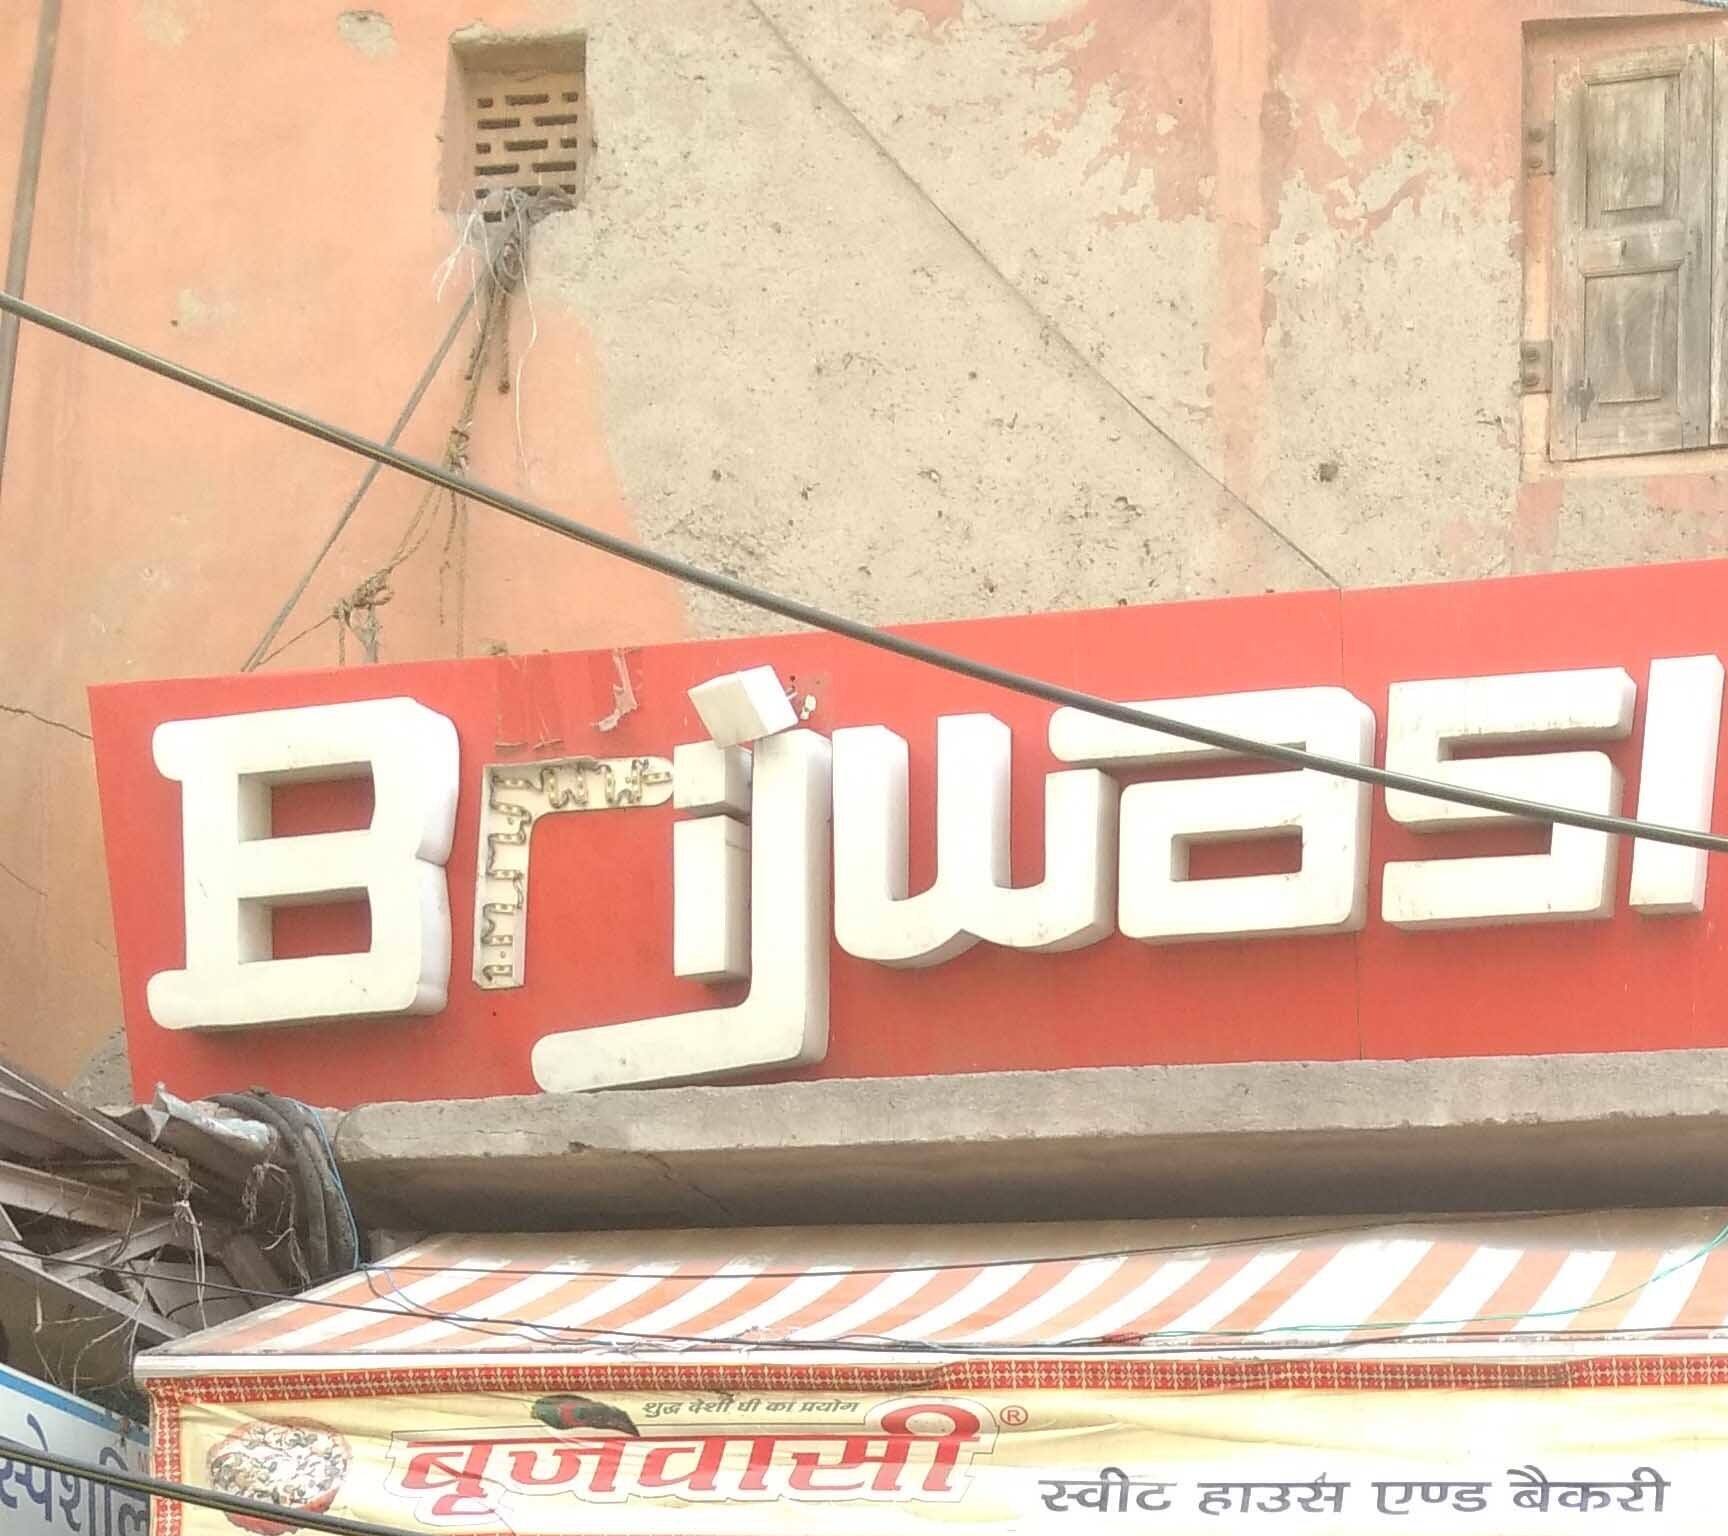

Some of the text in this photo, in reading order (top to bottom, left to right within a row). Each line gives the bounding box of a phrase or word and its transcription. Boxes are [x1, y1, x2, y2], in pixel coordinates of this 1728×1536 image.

[399, 1403, 982, 1516] बृजवासी
[1038, 1465, 1180, 1515] स्वीट
[1371, 1481, 1497, 1515] एण्ड
[1505, 1464, 1674, 1515] बैकरी
